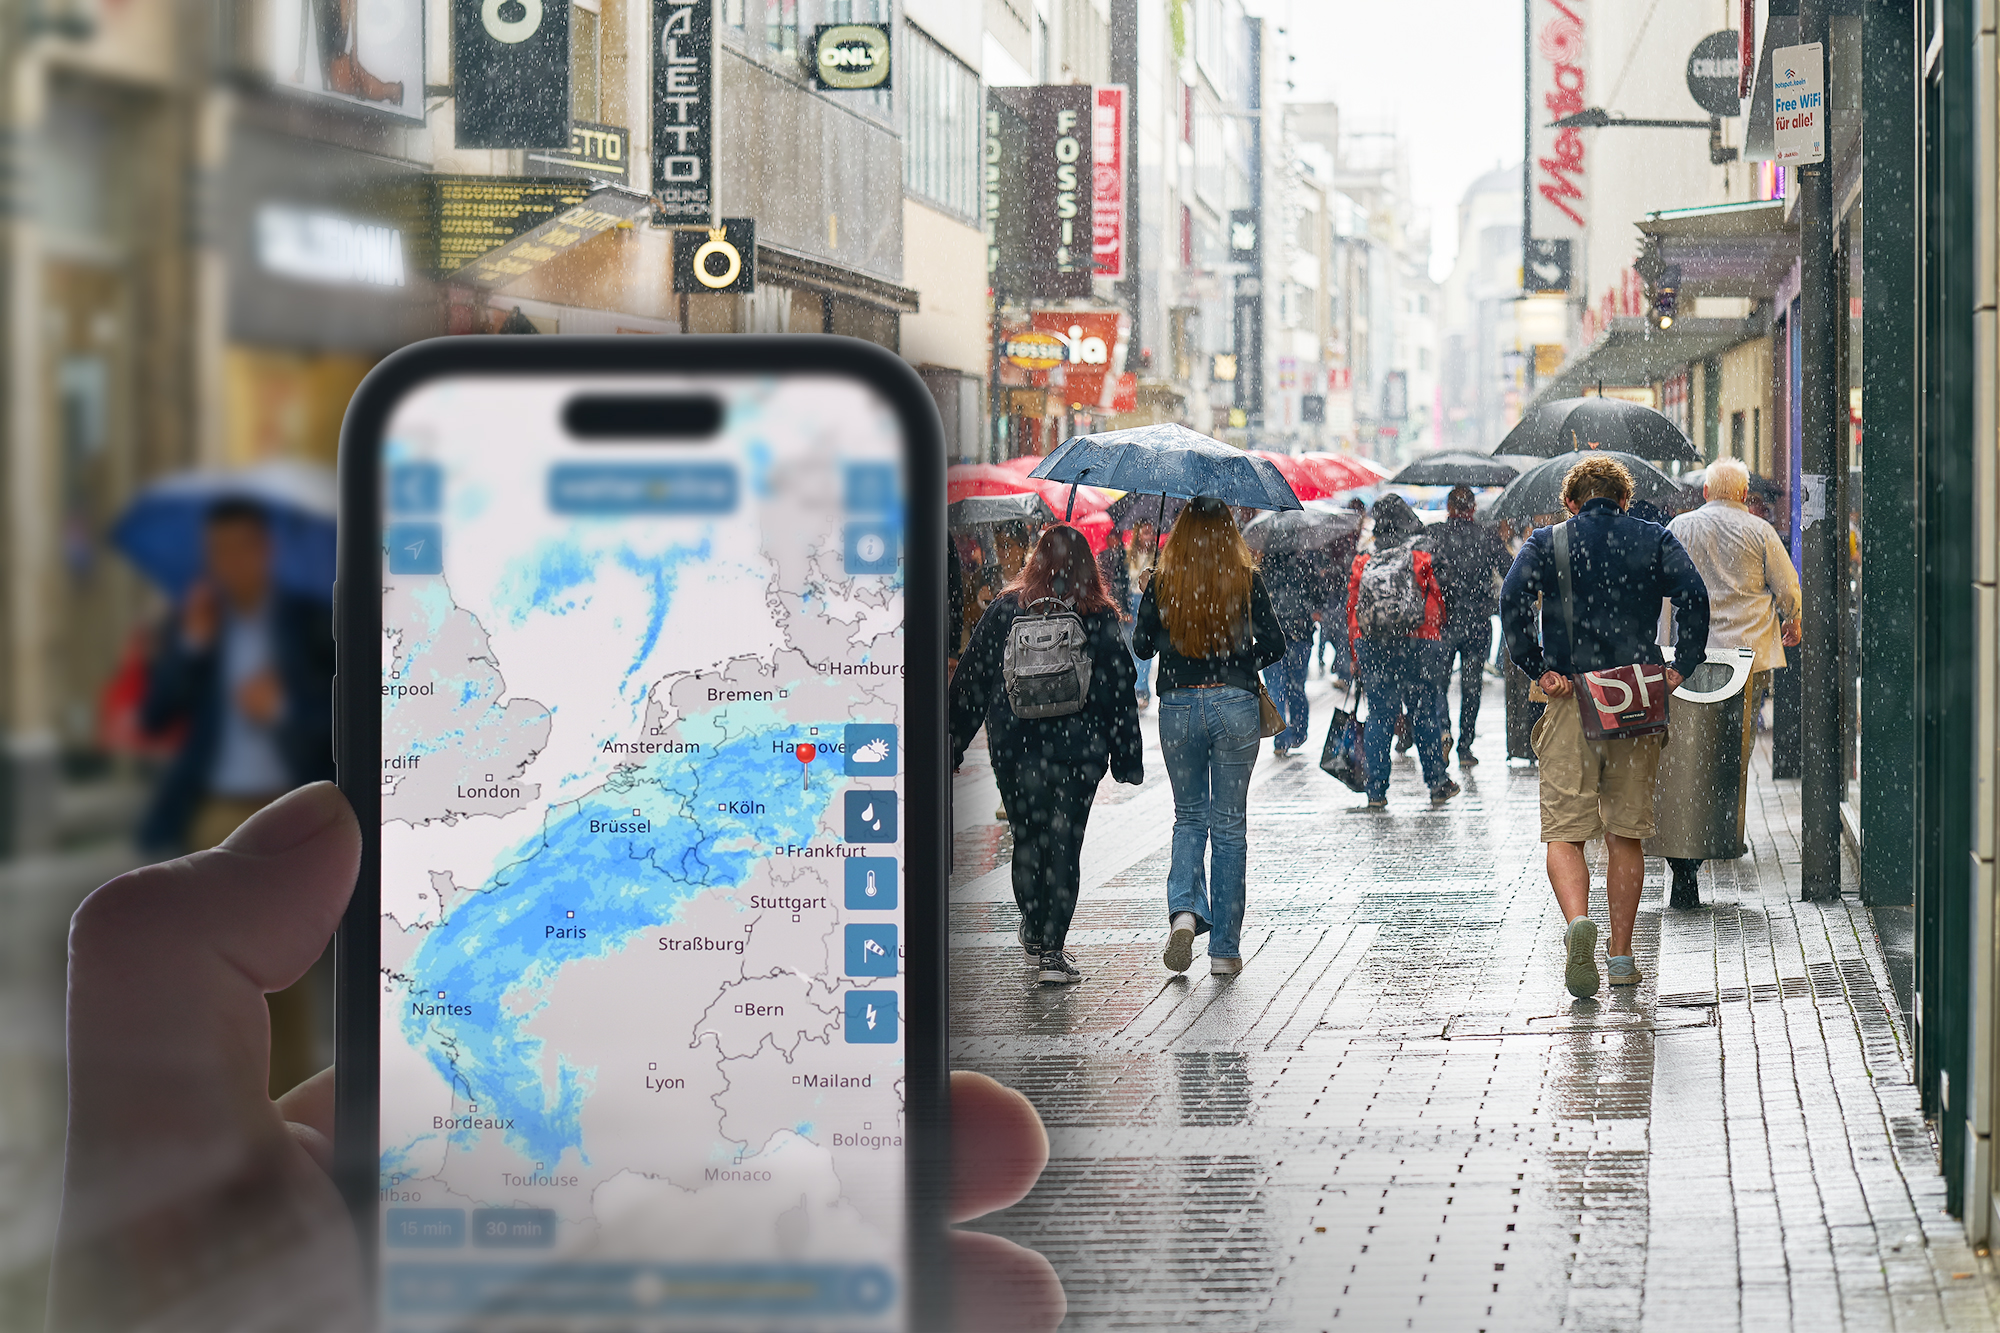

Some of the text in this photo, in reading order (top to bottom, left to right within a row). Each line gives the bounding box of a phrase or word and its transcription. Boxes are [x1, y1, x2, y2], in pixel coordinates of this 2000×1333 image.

[820, 46, 885, 67] ONLY
[660, 0, 702, 182] ALETTO
[1776, 92, 1821, 113] Free WiFi
[1776, 112, 1813, 130] für alle!
[1055, 110, 1080, 272] FOSSIL
[707, 686, 774, 702] Bremen
[602, 739, 700, 755] Amsterdam
[772, 740, 854, 754] Haover
[384, 755, 421, 769] rdiff
[457, 784, 520, 799] London
[729, 799, 765, 815] Köln
[589, 818, 651, 834] Brüssel
[787, 844, 867, 858] Frankfurt
[750, 894, 827, 912] Stuttgart
[544, 924, 587, 939] Paris
[658, 936, 745, 954] Straßburg
[411, 1002, 472, 1016] Nantes
[745, 1002, 785, 1017] Bern
[646, 1074, 686, 1091] Lyon
[803, 1072, 871, 1088] Mailand
[433, 1114, 515, 1130] Bordeaux
[833, 1132, 903, 1151] Bologna
[502, 1172, 579, 1187] Toulouse
[704, 1166, 772, 1182] Monaco
[379, 1188, 422, 1203] ilbao
[400, 1220, 452, 1236] 15 min
[486, 1220, 542, 1236] 30 min
